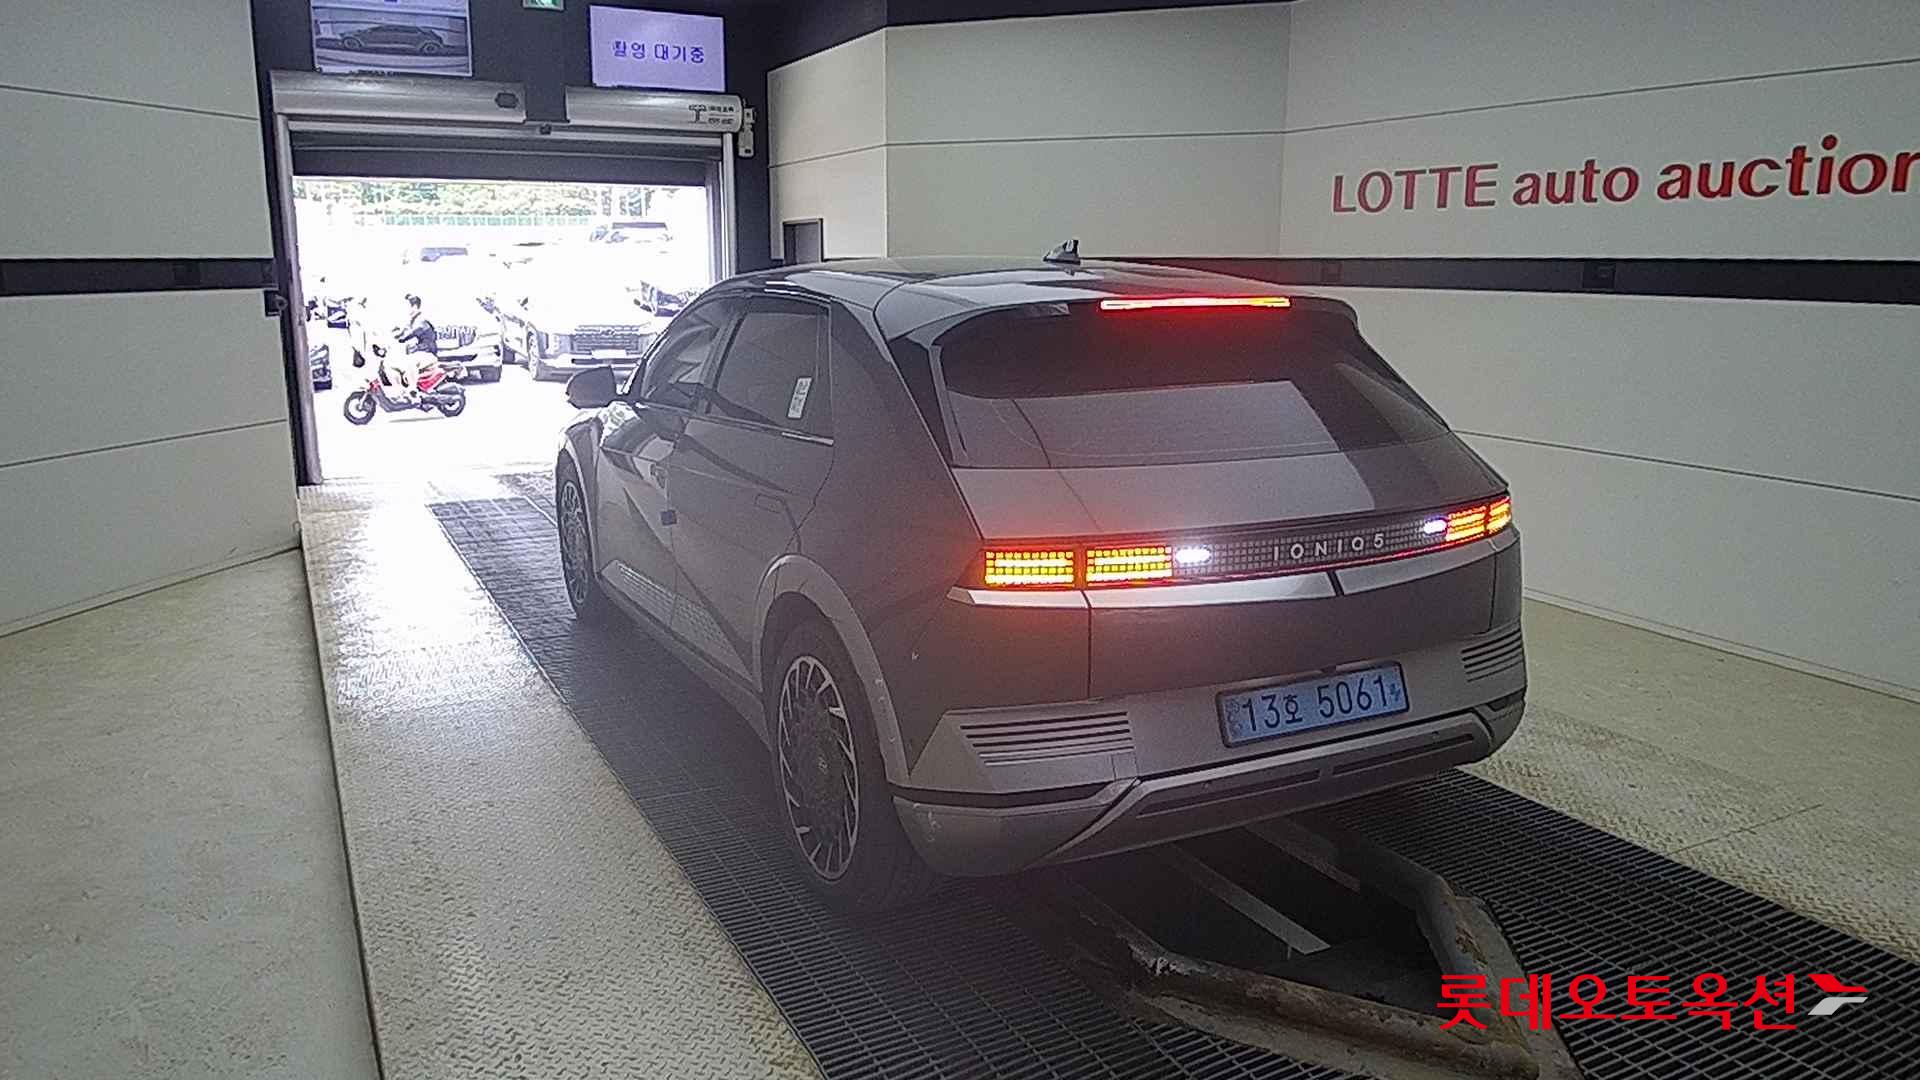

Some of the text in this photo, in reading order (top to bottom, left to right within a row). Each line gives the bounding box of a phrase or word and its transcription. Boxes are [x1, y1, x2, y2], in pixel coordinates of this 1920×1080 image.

[654, 44, 704, 63] 대기중
[1332, 163, 1499, 213] LOTTE
[1512, 159, 1640, 205] auto
[1242, 675, 1388, 732] 13호 5061
